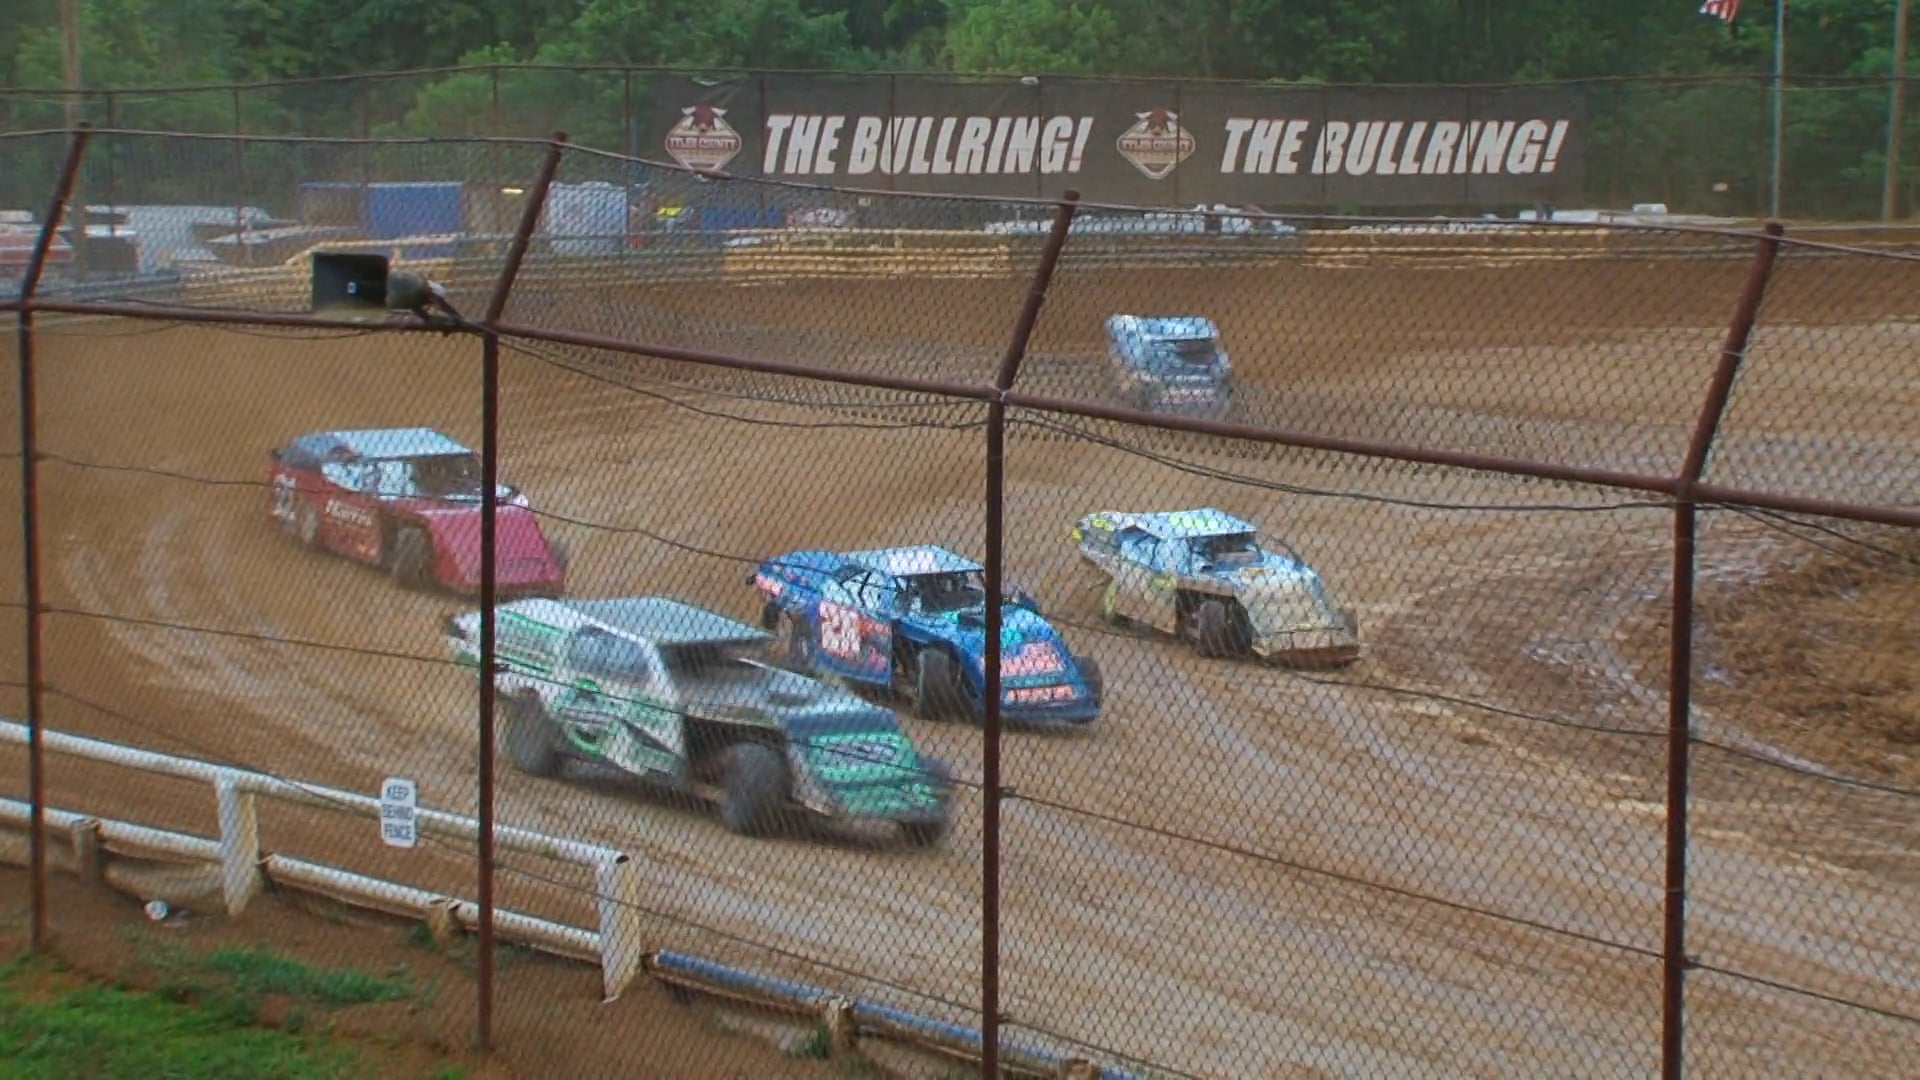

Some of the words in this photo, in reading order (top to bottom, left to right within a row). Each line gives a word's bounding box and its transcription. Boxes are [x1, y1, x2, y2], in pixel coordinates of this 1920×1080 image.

[763, 115, 845, 174] THE
[848, 116, 1094, 174] BULLRING!
[1220, 118, 1308, 174] THE
[1311, 120, 1569, 175] BULLRING!
[386, 784, 410, 801] KEEP
